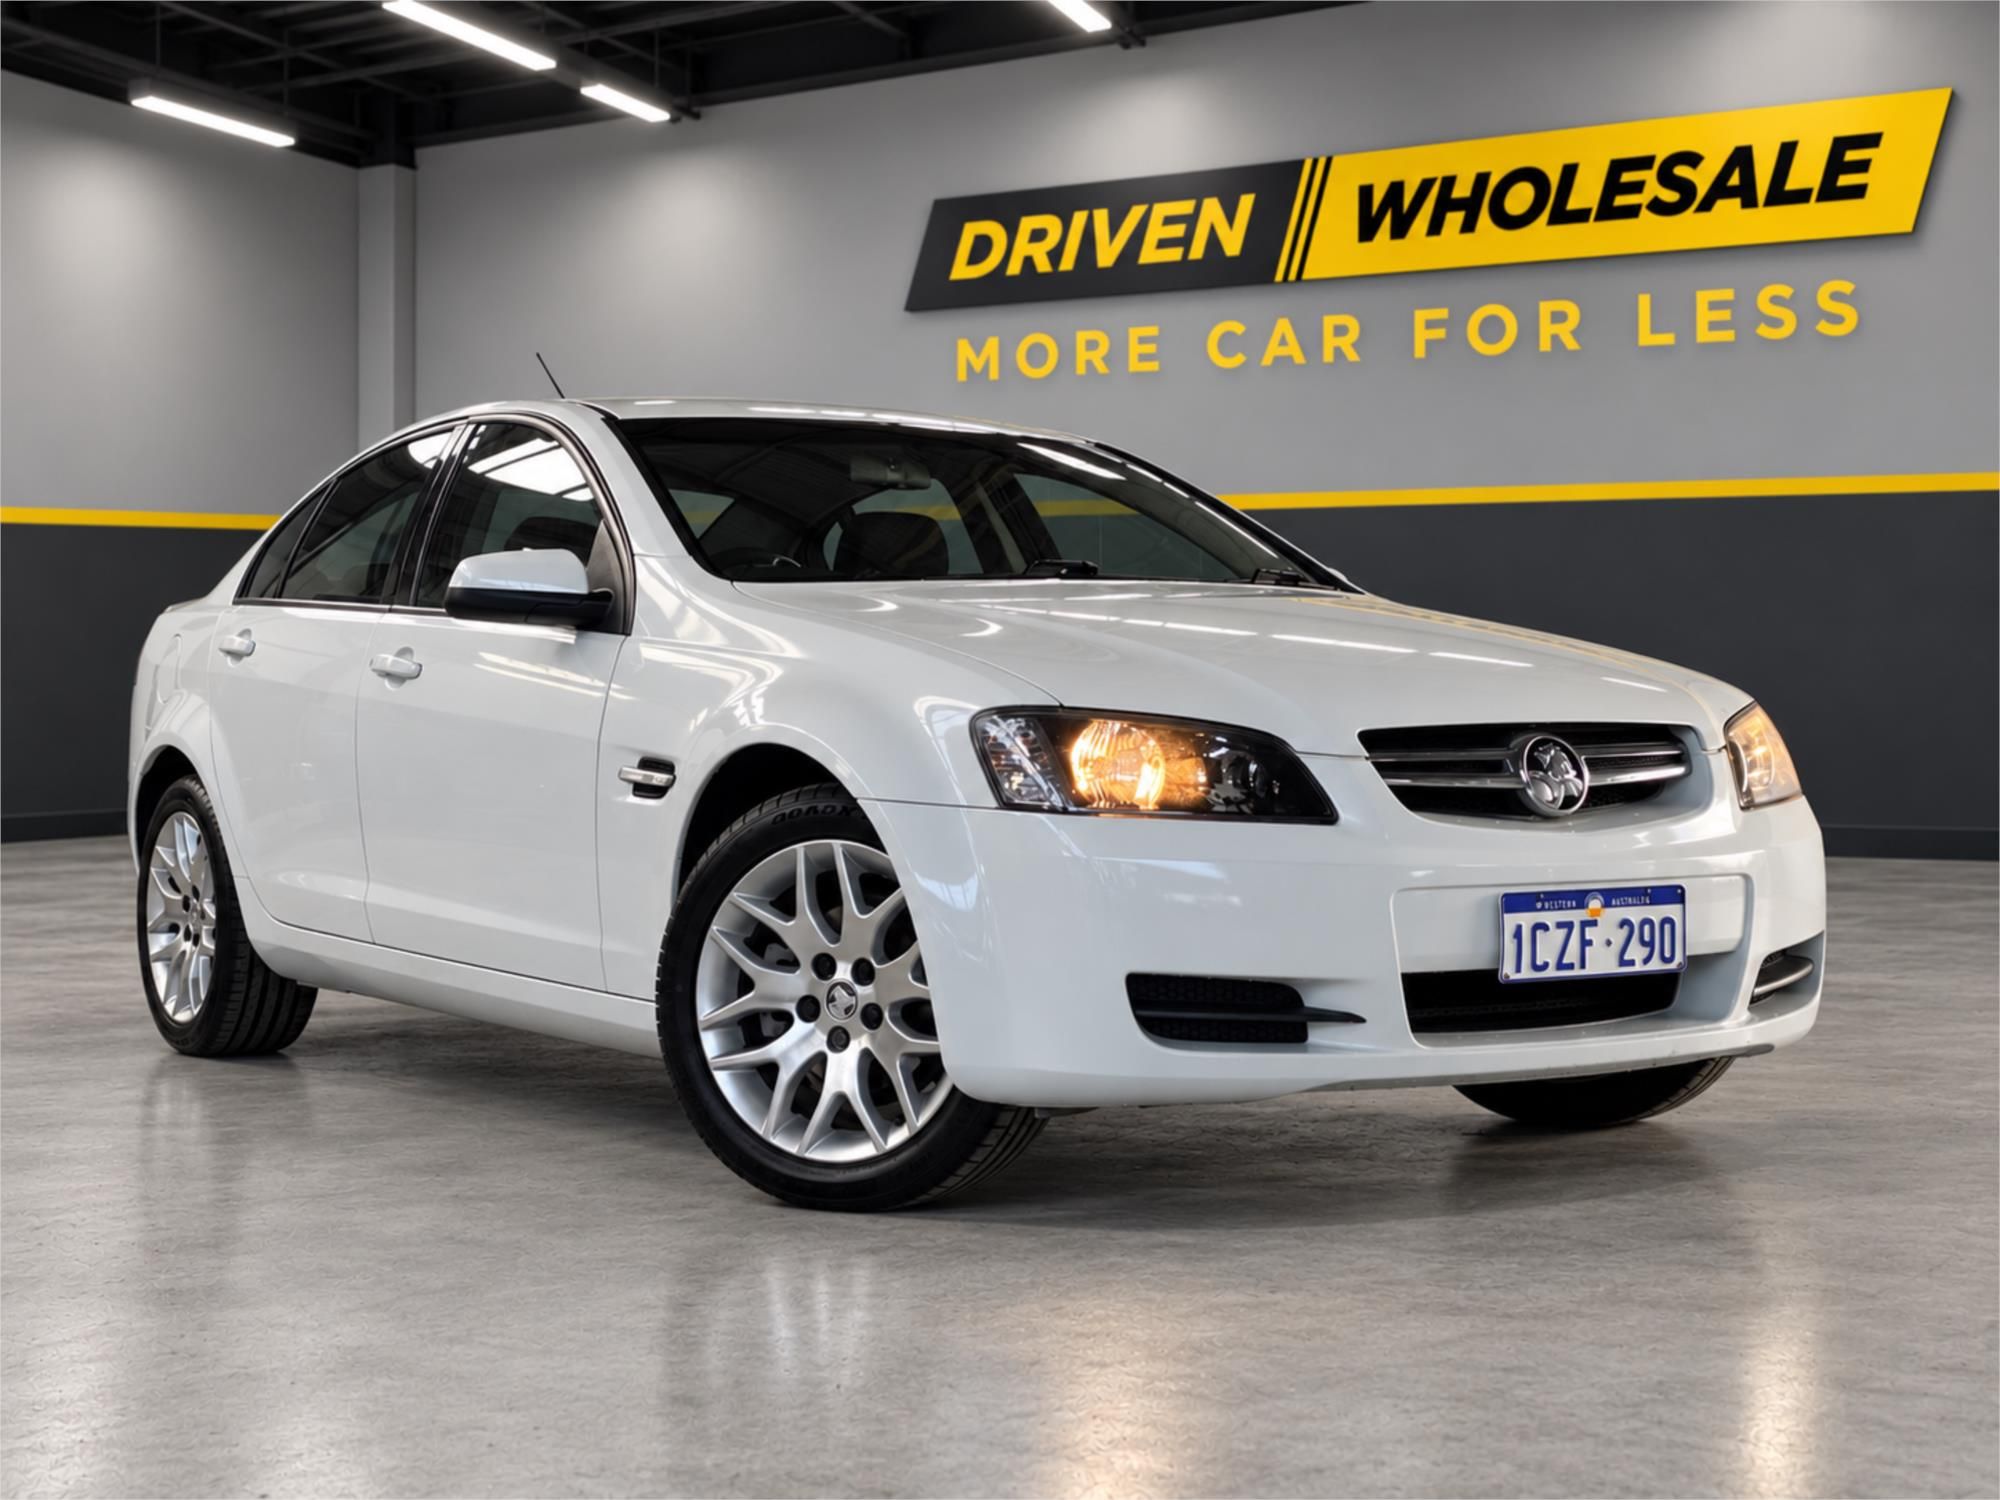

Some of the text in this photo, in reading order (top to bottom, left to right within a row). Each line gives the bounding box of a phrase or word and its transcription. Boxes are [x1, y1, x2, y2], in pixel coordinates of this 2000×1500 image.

[948, 132, 1883, 281] DRIVEN WHOLESALE
[956, 279, 1860, 382] MORE CAR FOR LESS
